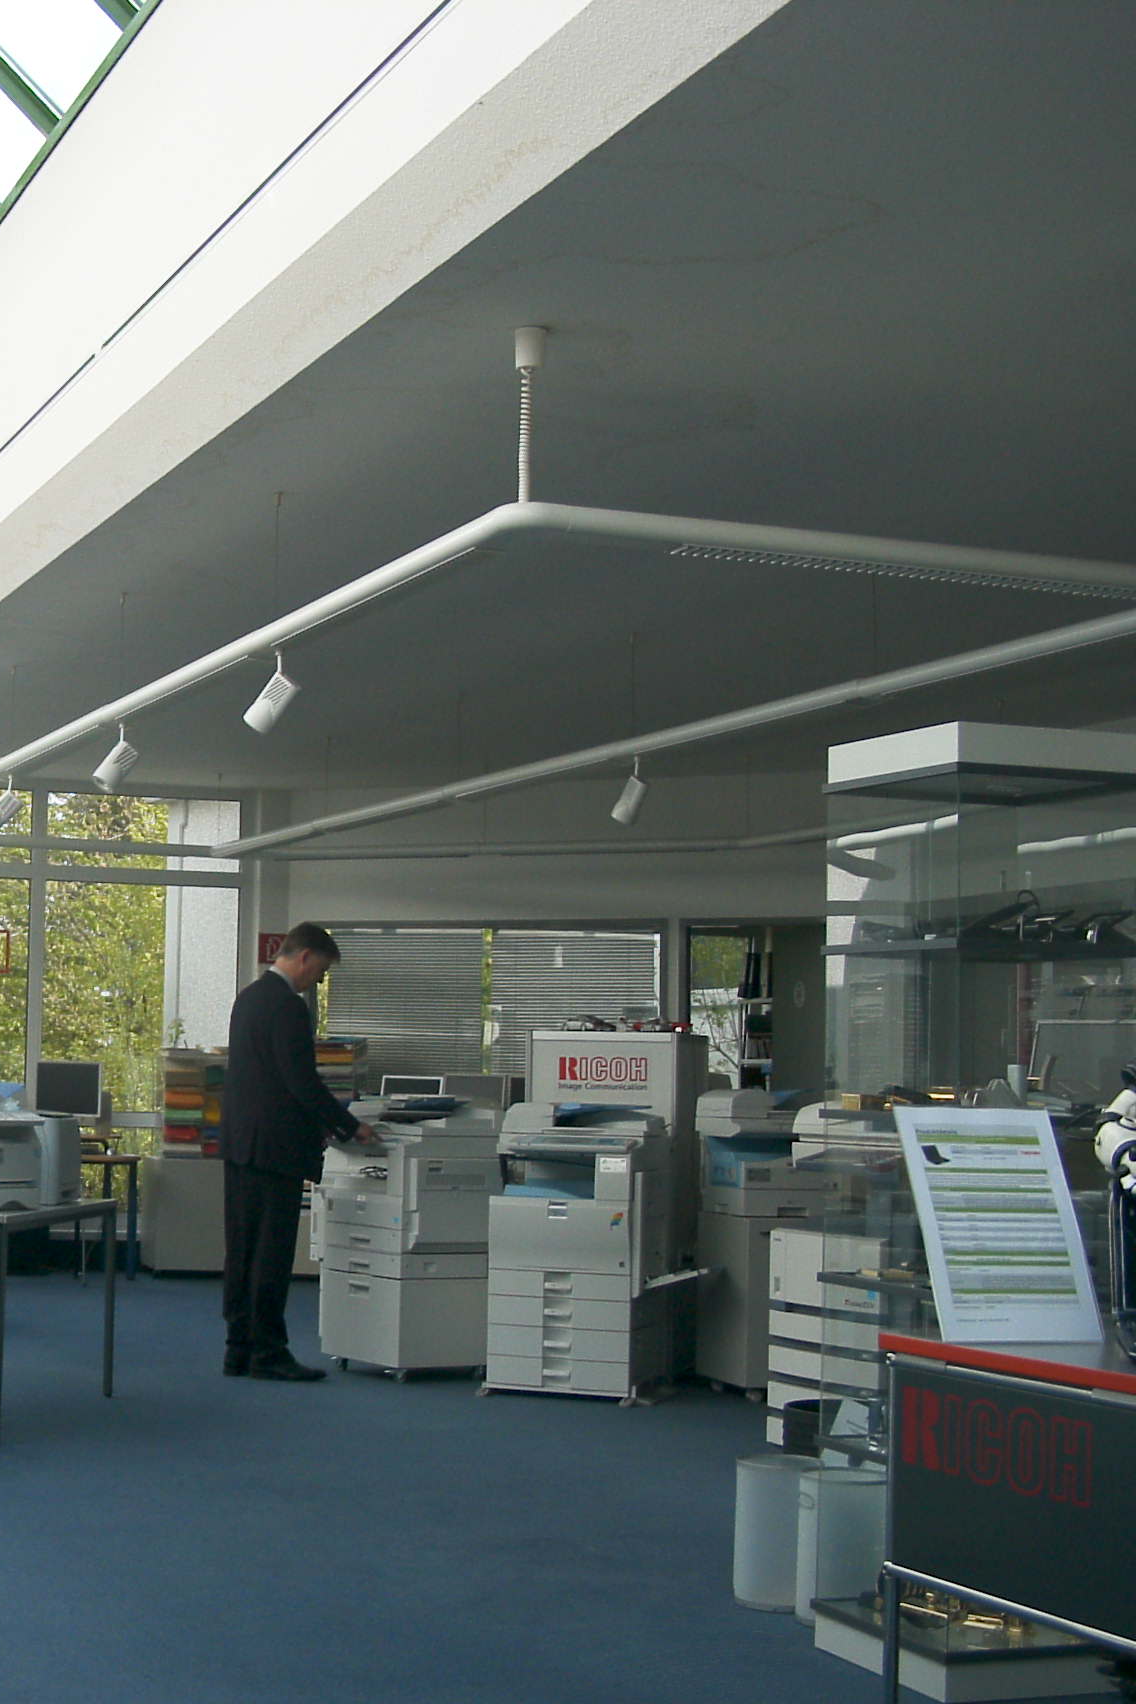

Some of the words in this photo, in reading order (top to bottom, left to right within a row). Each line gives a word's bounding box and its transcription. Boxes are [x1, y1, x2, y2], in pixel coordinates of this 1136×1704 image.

[559, 1056, 648, 1081] RICOH
[558, 1082, 582, 1091] Image
[585, 1082, 648, 1090] Communication
[902, 1385, 1094, 1507] RICOH
